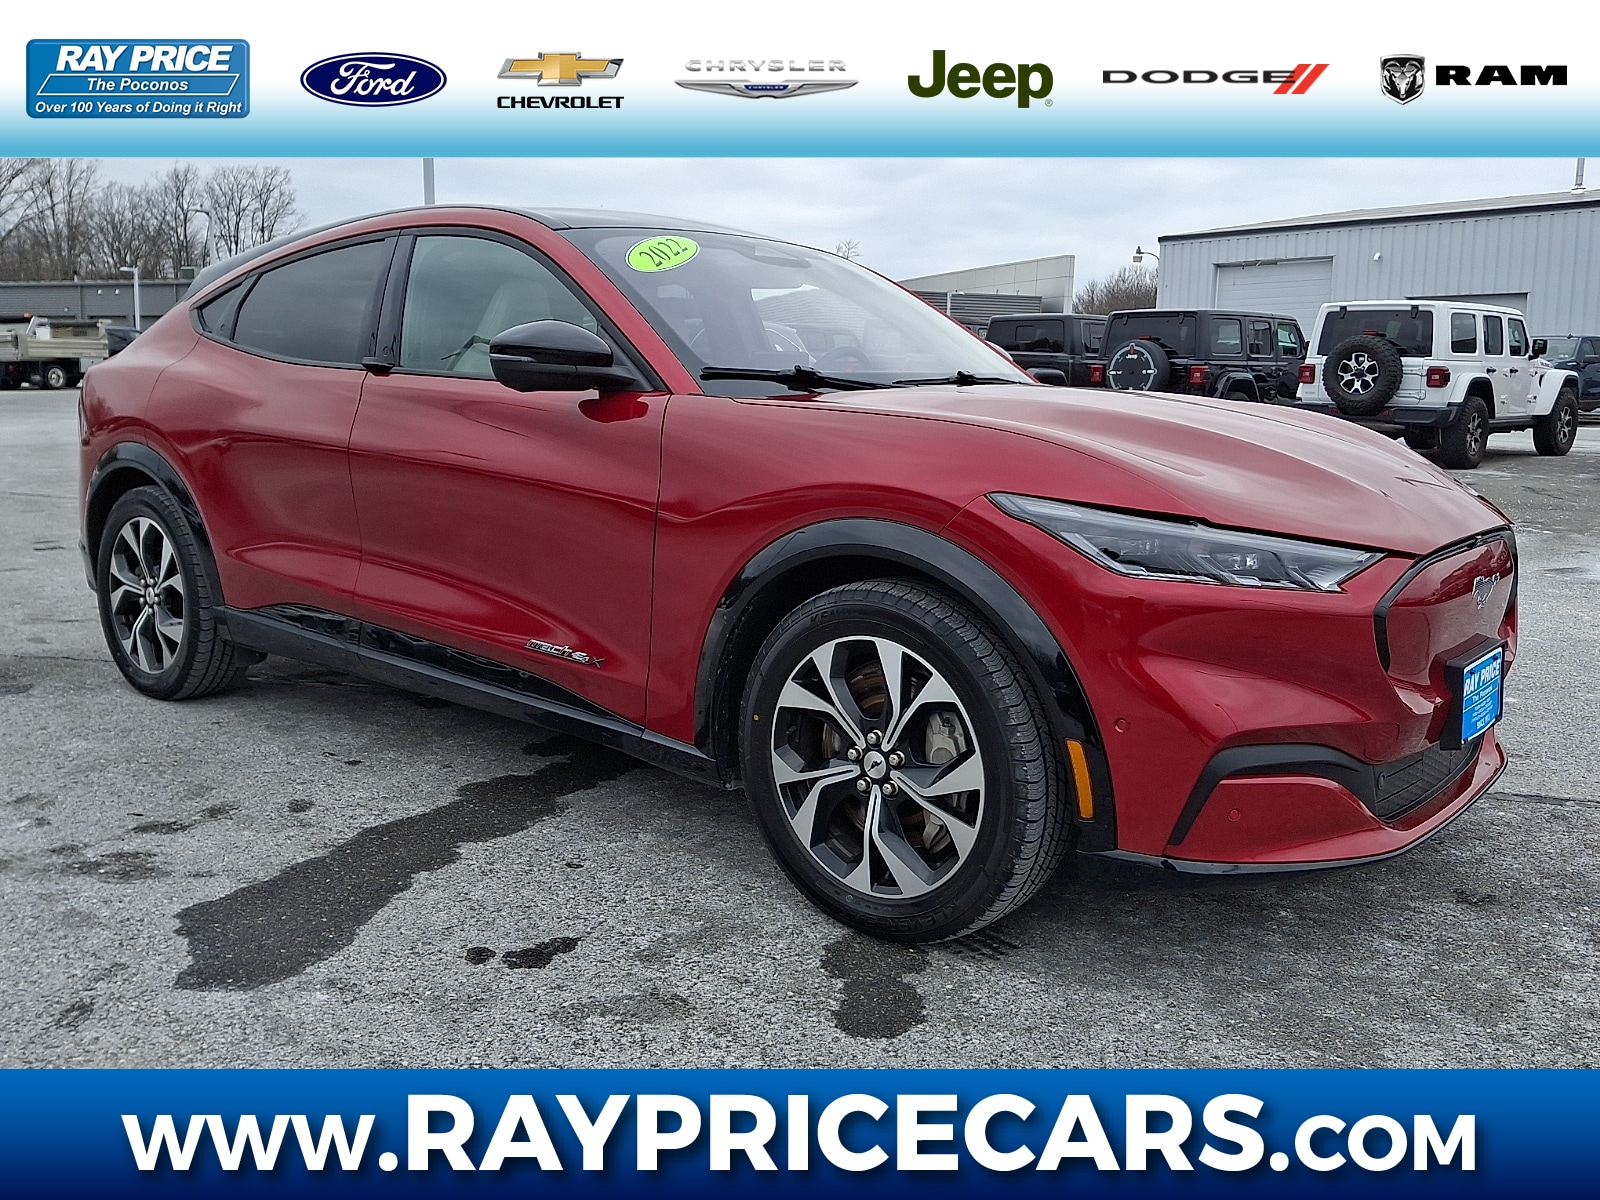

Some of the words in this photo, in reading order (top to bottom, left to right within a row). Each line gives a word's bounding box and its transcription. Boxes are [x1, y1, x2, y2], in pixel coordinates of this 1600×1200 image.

[639, 239, 688, 267] 2022
[1464, 671, 1481, 697] RAY
[1480, 659, 1501, 687] PRICE
